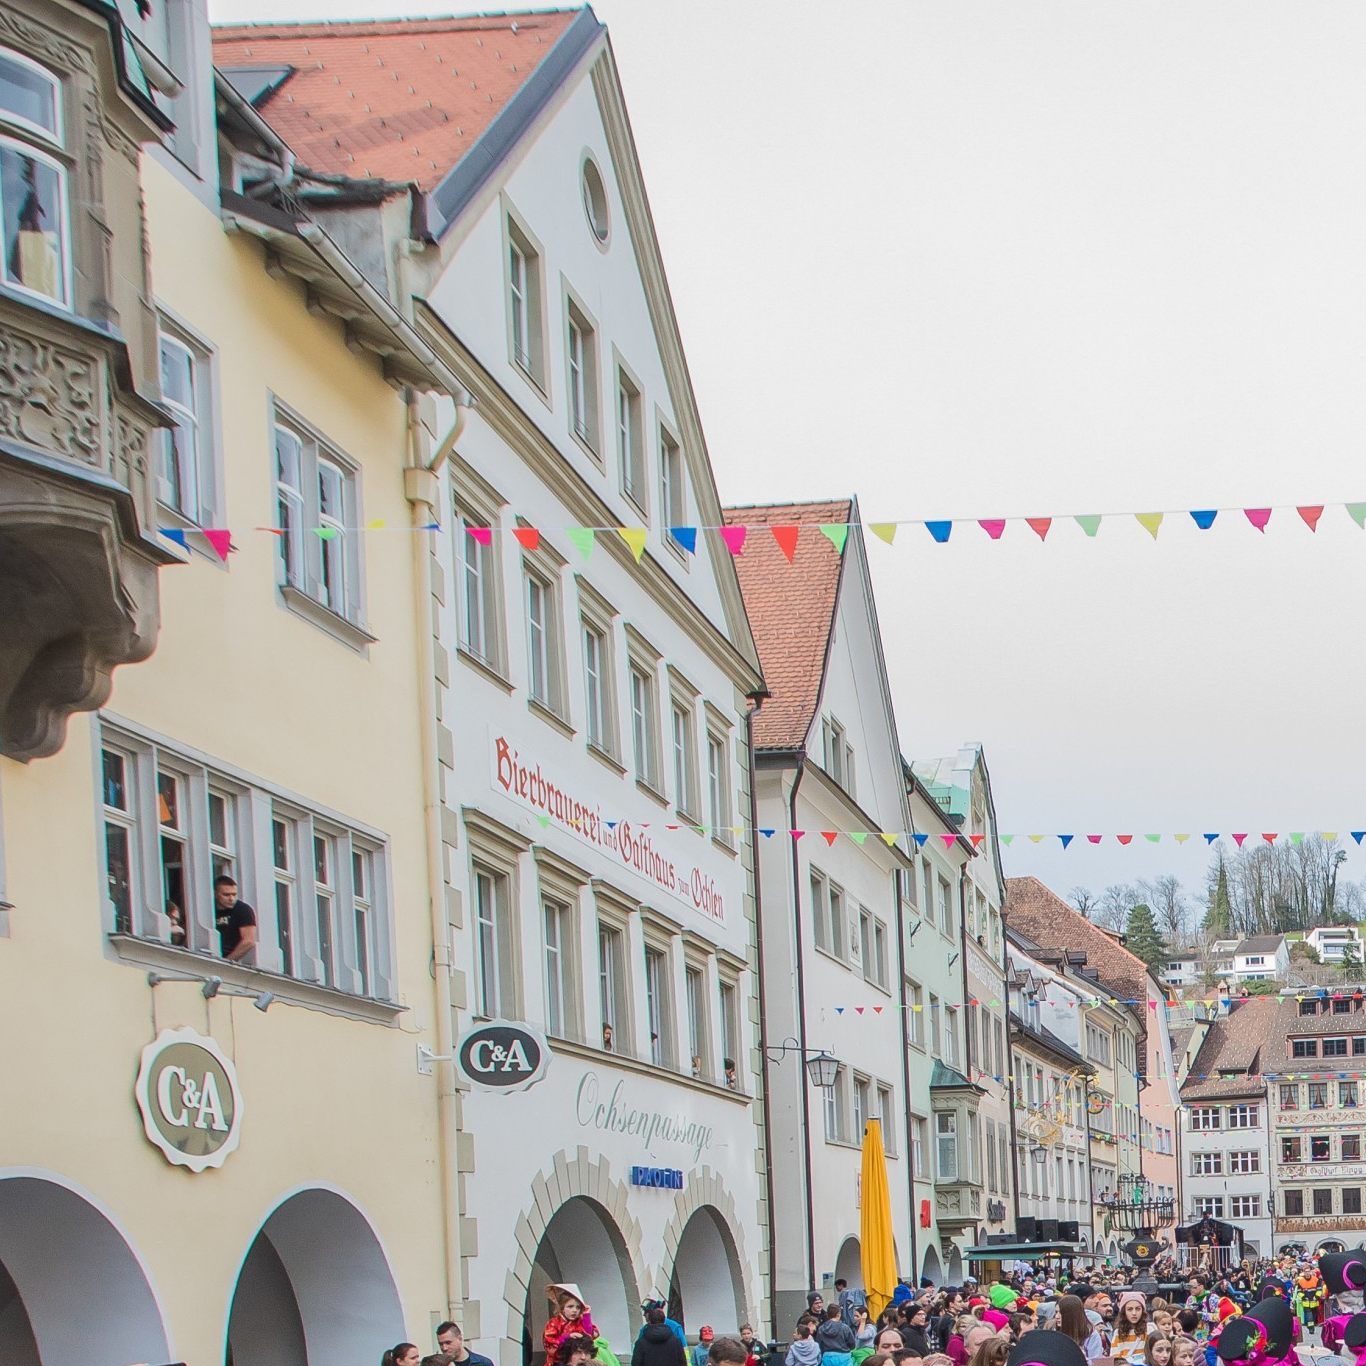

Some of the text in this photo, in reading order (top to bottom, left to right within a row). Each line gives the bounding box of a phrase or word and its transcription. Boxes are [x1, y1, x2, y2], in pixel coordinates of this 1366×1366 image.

[495, 736, 602, 846] Bierbrauerei
[469, 1039, 533, 1073] C&A
[157, 1065, 228, 1131] C&A
[576, 1072, 714, 1163] Ochsenpassage
